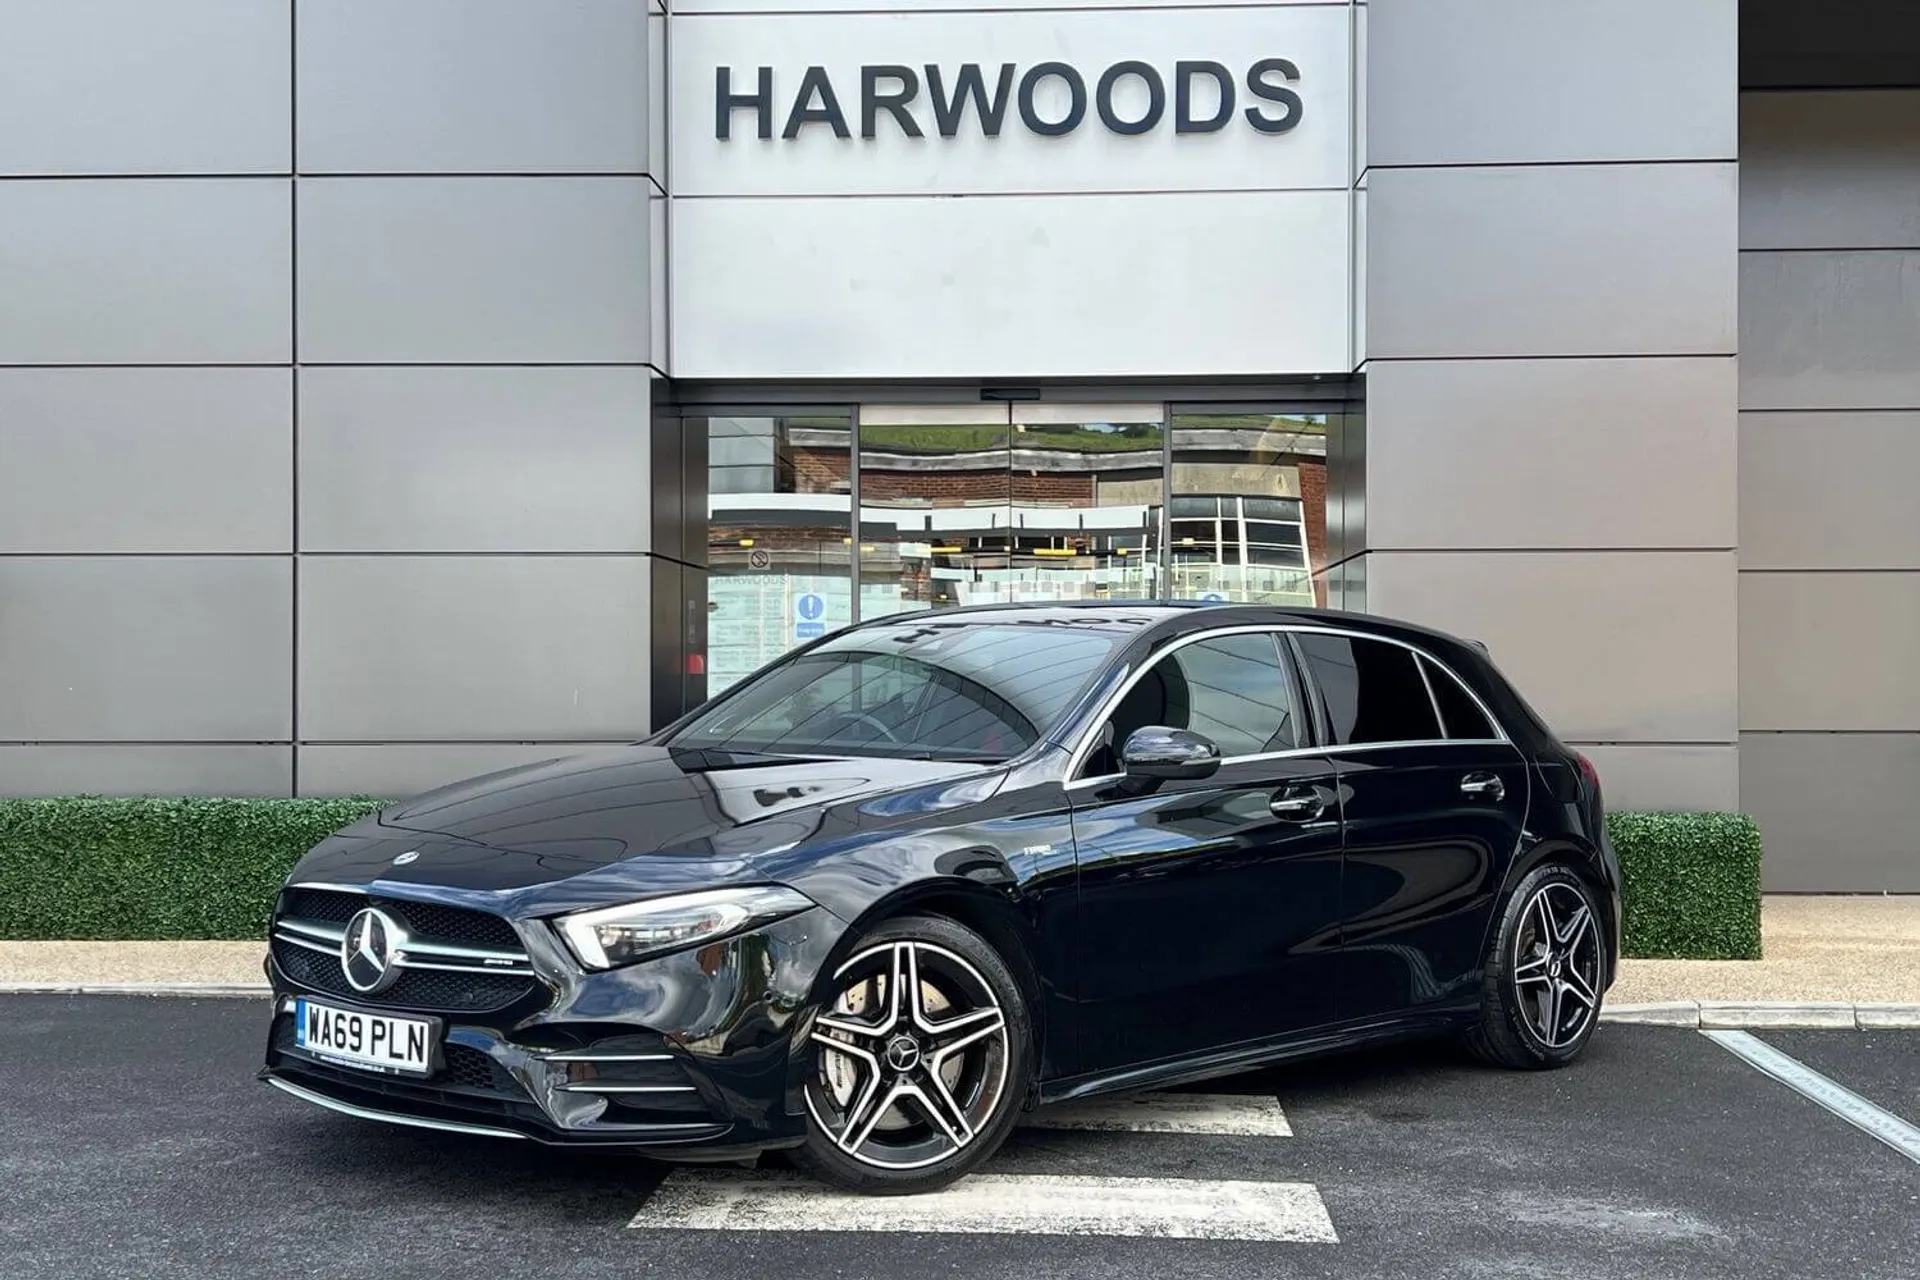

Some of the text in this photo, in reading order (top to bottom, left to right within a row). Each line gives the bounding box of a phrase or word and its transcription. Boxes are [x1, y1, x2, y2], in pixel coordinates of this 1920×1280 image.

[715, 58, 1304, 139] HARWOODS
[309, 1005, 425, 1064] WA69 PLN
